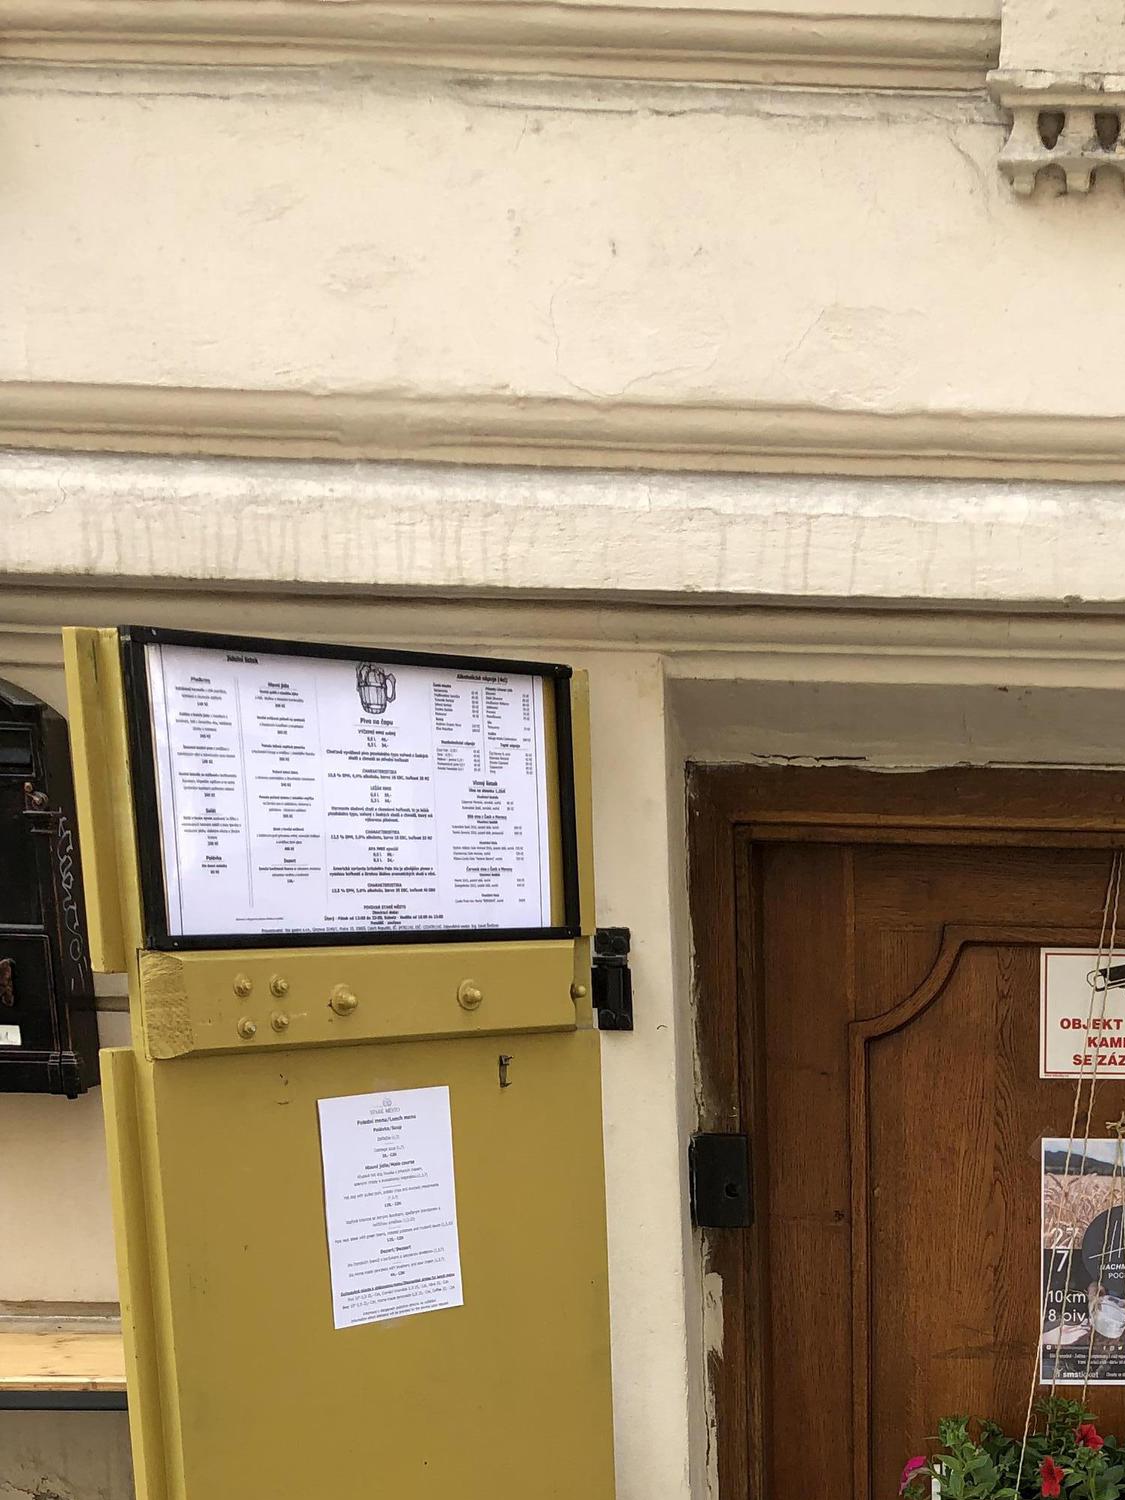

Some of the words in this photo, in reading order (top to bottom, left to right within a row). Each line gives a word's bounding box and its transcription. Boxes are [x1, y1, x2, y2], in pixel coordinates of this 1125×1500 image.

[1060, 1018, 1123, 1030] OBJEKT
[1072, 1054, 1093, 1066] SE
[1051, 1228, 1079, 1249] 27
[1056, 1250, 1069, 1272] 7
[1048, 1290, 1086, 1303] 10km
[1048, 1309, 1056, 1322] 8
